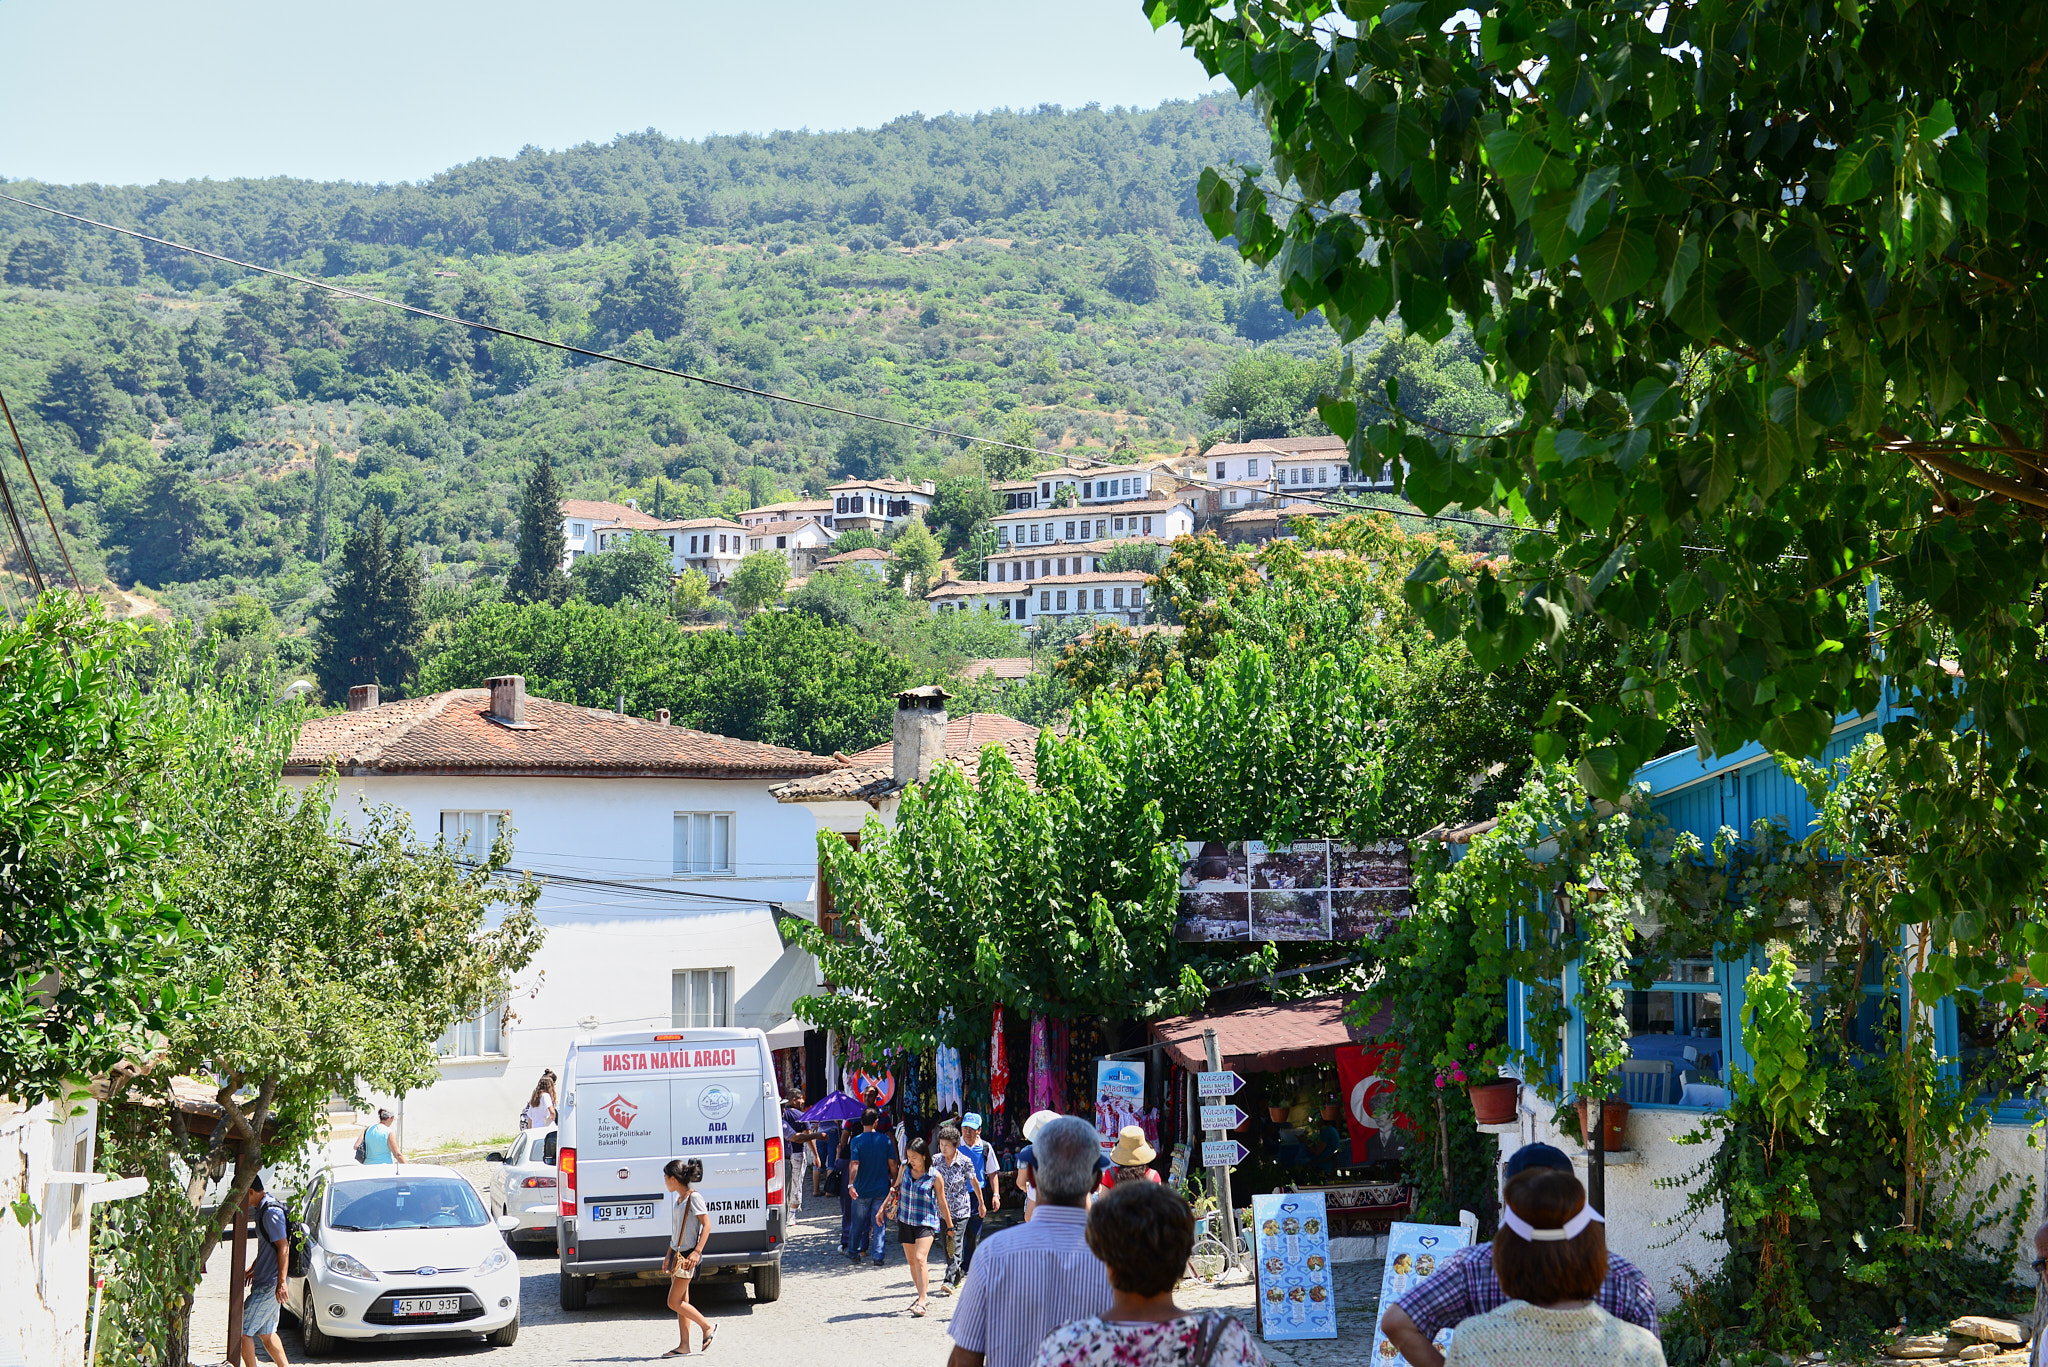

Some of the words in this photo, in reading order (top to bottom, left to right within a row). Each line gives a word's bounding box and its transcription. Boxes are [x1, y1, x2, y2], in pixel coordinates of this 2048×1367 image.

[603, 1053, 648, 1072] HASTA
[650, 1048, 691, 1070] NAKİL
[694, 1049, 736, 1068] ARACI
[1104, 1084, 1135, 1093] Madran
[708, 1122, 727, 1131] ADA
[598, 1131, 618, 1139] Sosyal
[682, 1135, 713, 1146] BAKIM
[715, 1132, 755, 1144] MERKEZİ
[705, 1201, 733, 1212] HASTA
[734, 1197, 760, 1210] NAKİL
[599, 1207, 612, 1218] 09
[616, 1206, 628, 1217] BV
[634, 1205, 652, 1216] 120
[718, 1214, 746, 1225] ARACI
[399, 1301, 413, 1312] 45
[419, 1300, 432, 1311] KD
[438, 1299, 458, 1310] 935
